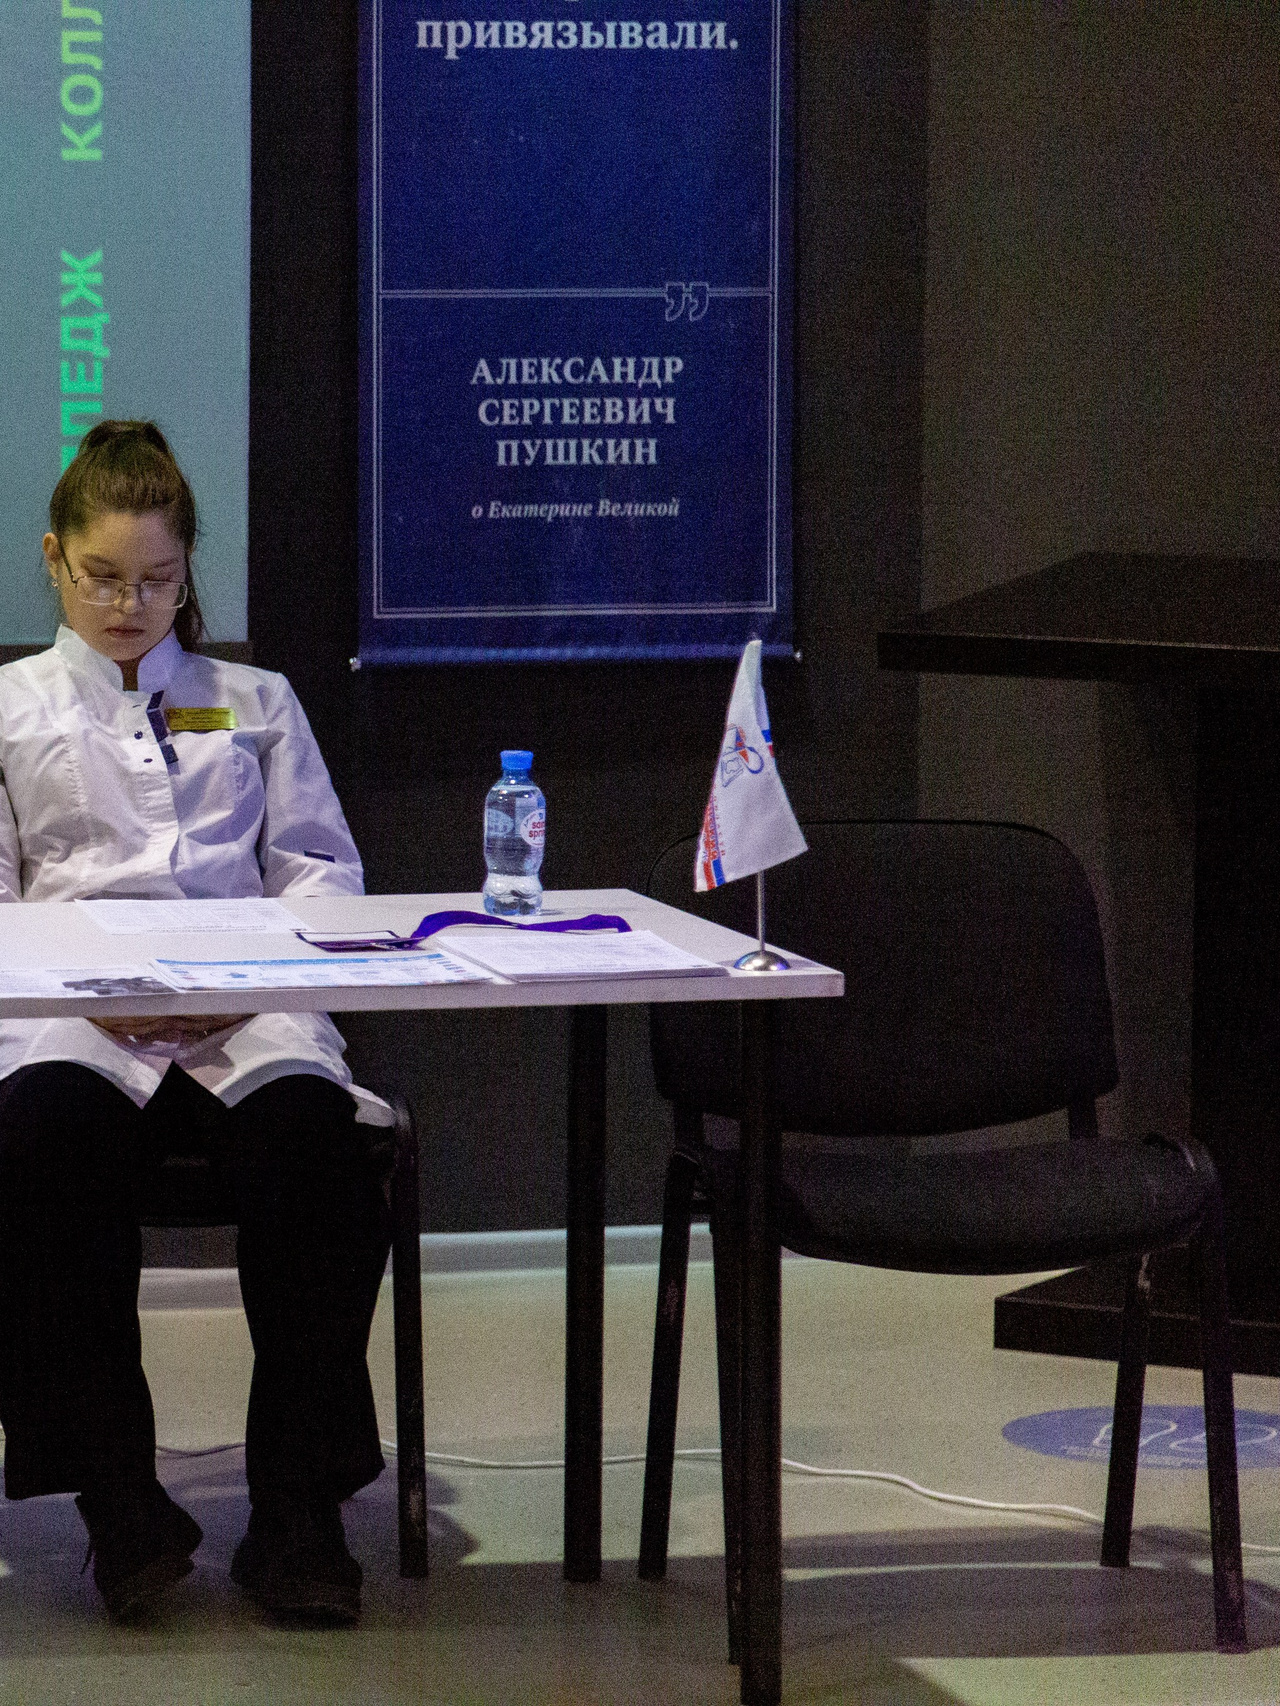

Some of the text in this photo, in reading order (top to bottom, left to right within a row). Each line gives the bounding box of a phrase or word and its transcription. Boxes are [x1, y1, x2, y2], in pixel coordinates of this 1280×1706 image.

[416, 20, 739, 59] привязывали.
[60, 249, 110, 474] ЛЕДЖ
[470, 356, 685, 387] АЛЕКСАНДР
[477, 397, 677, 426] СЕРГЕЕВИЧ
[495, 438, 658, 466] ПУШКИН
[471, 496, 680, 520] о Екатерине Великой
